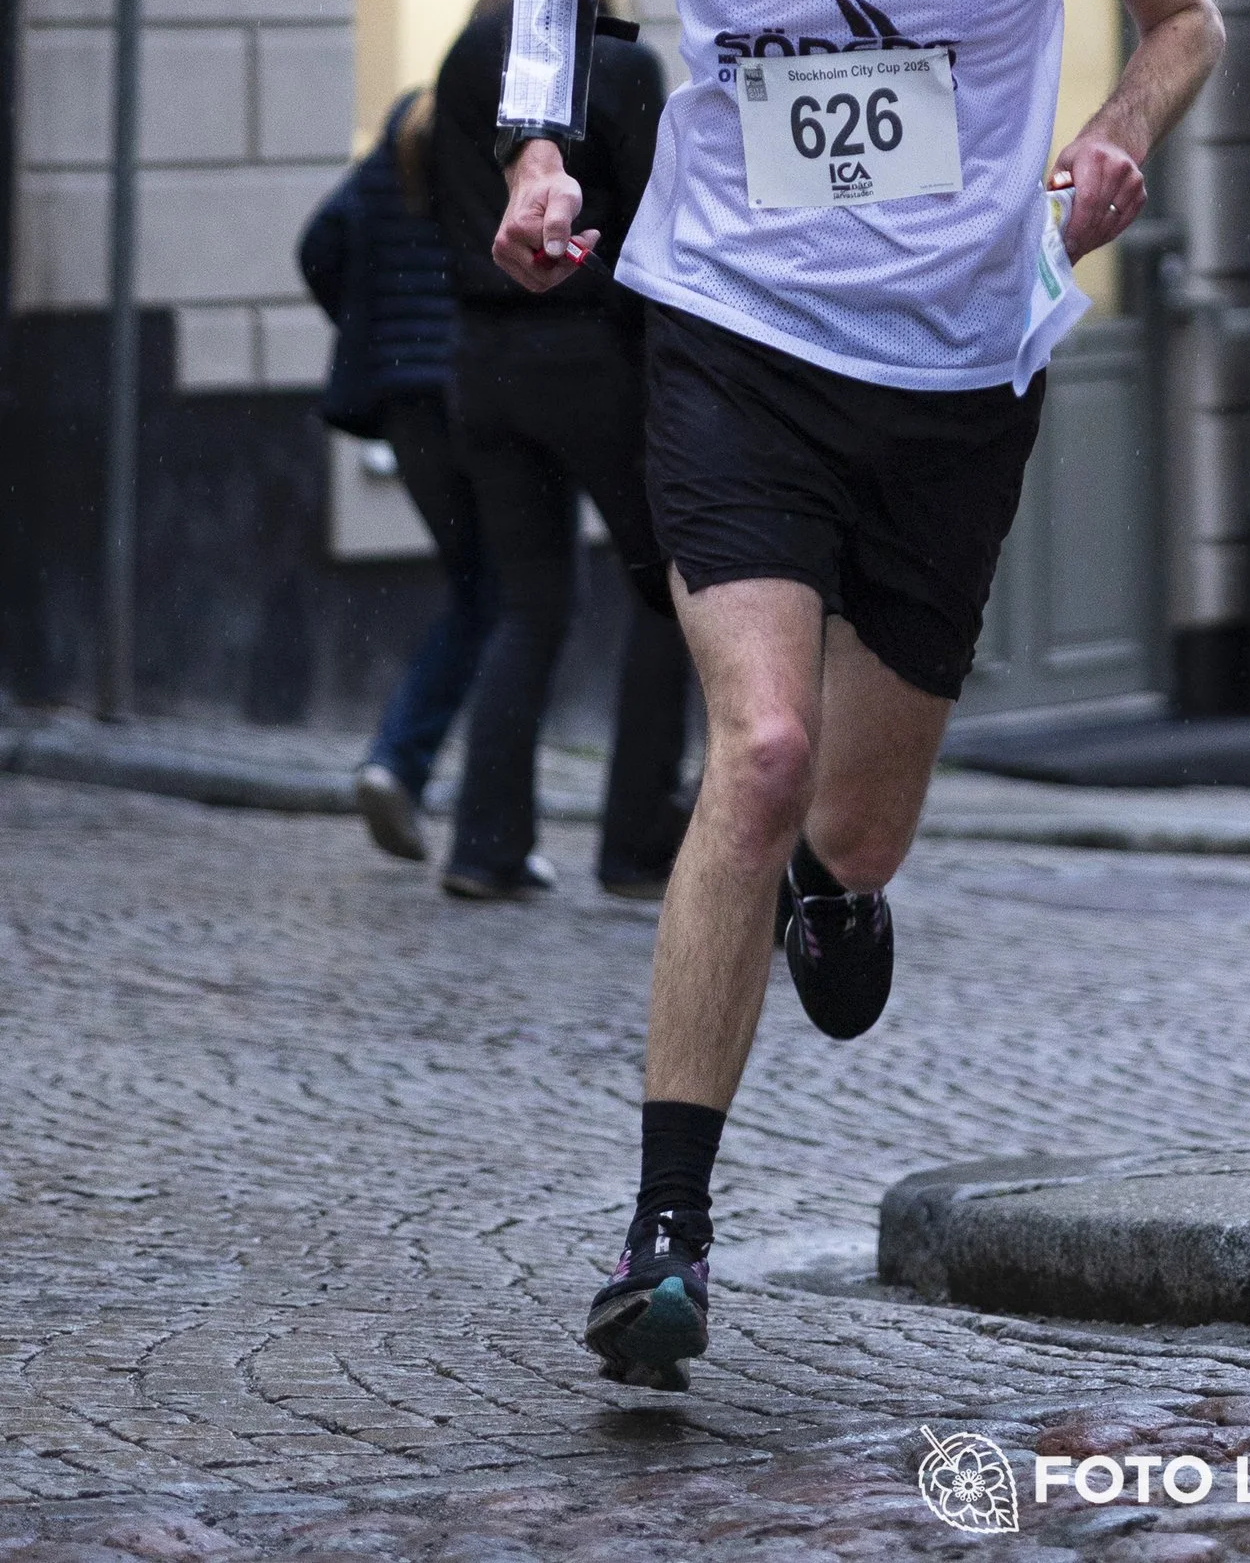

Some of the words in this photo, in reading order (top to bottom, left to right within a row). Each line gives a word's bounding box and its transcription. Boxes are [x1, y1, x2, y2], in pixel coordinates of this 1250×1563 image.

[787, 68, 848, 82] Stockholm
[850, 65, 874, 78] City
[877, 62, 901, 75] Cup
[903, 61, 931, 72] 2025
[790, 87, 904, 160] 626
[828, 161, 872, 184] ICA
